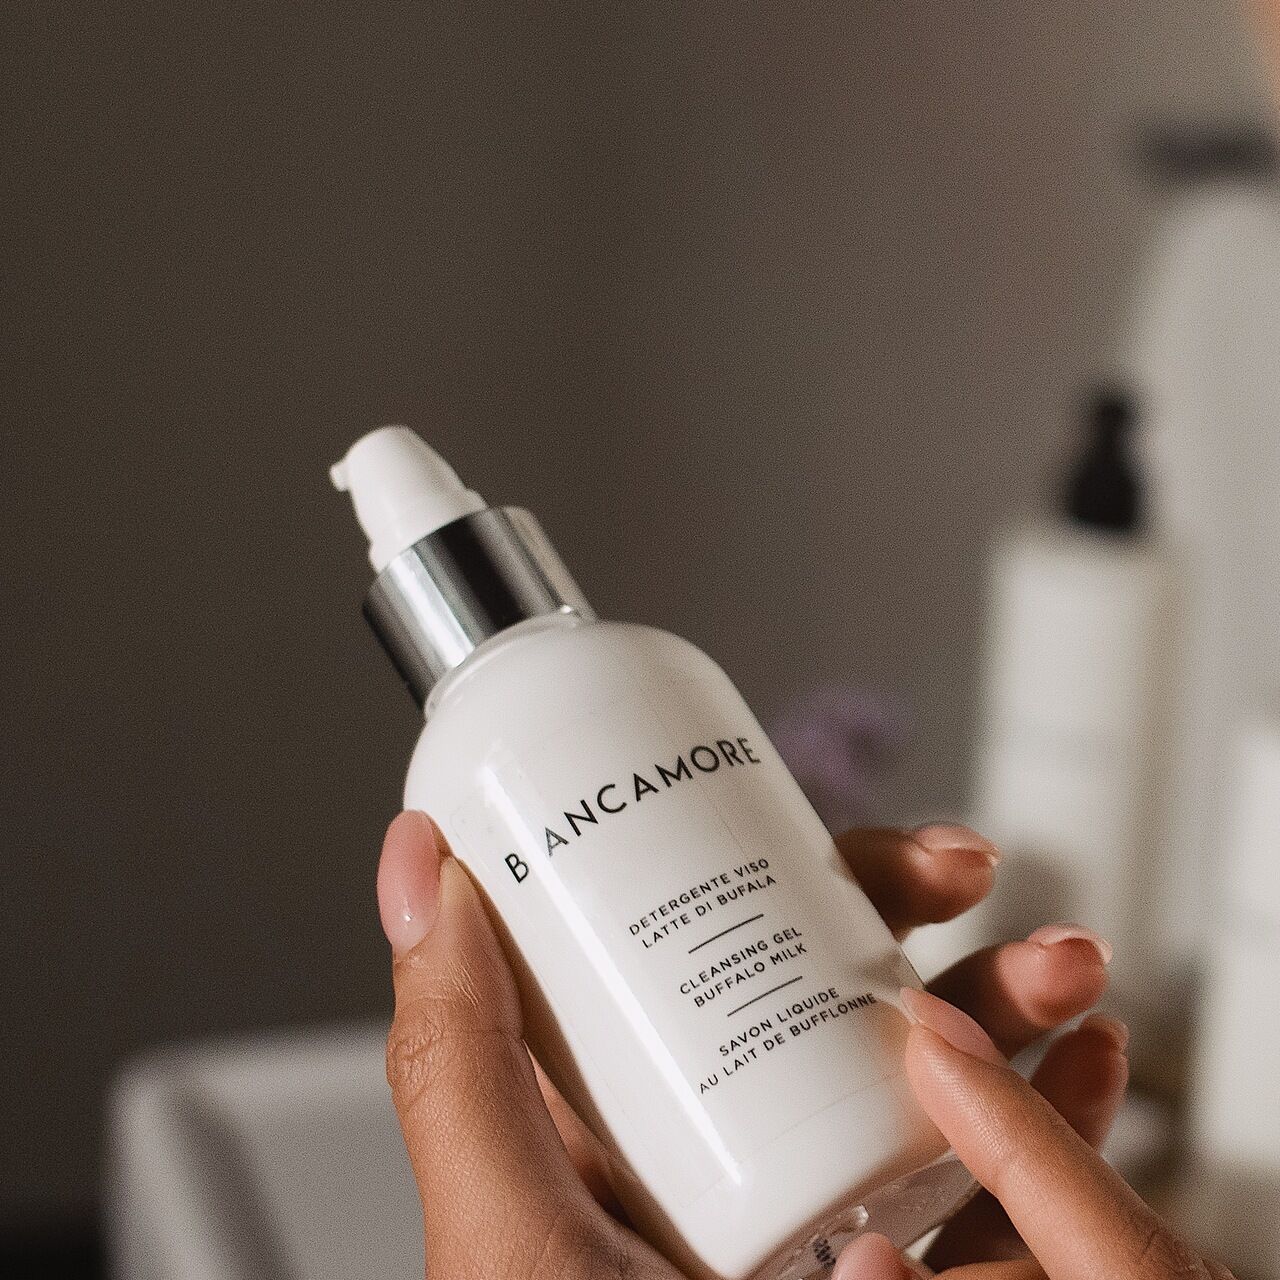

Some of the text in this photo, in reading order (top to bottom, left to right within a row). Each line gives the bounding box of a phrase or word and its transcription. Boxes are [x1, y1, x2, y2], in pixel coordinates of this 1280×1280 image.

[504, 737, 761, 883] BANCAMORE
[629, 858, 770, 936] DETERGENTE VISO
[642, 875, 777, 949] LATTE DI BUFALA
[679, 926, 803, 995] CLEANSING GEL
[693, 943, 808, 1008] BUFFALO MILK
[699, 992, 877, 1094] AU LAIT DE BUFFLONNE
[719, 987, 841, 1057] SAVON LIQUIDE
